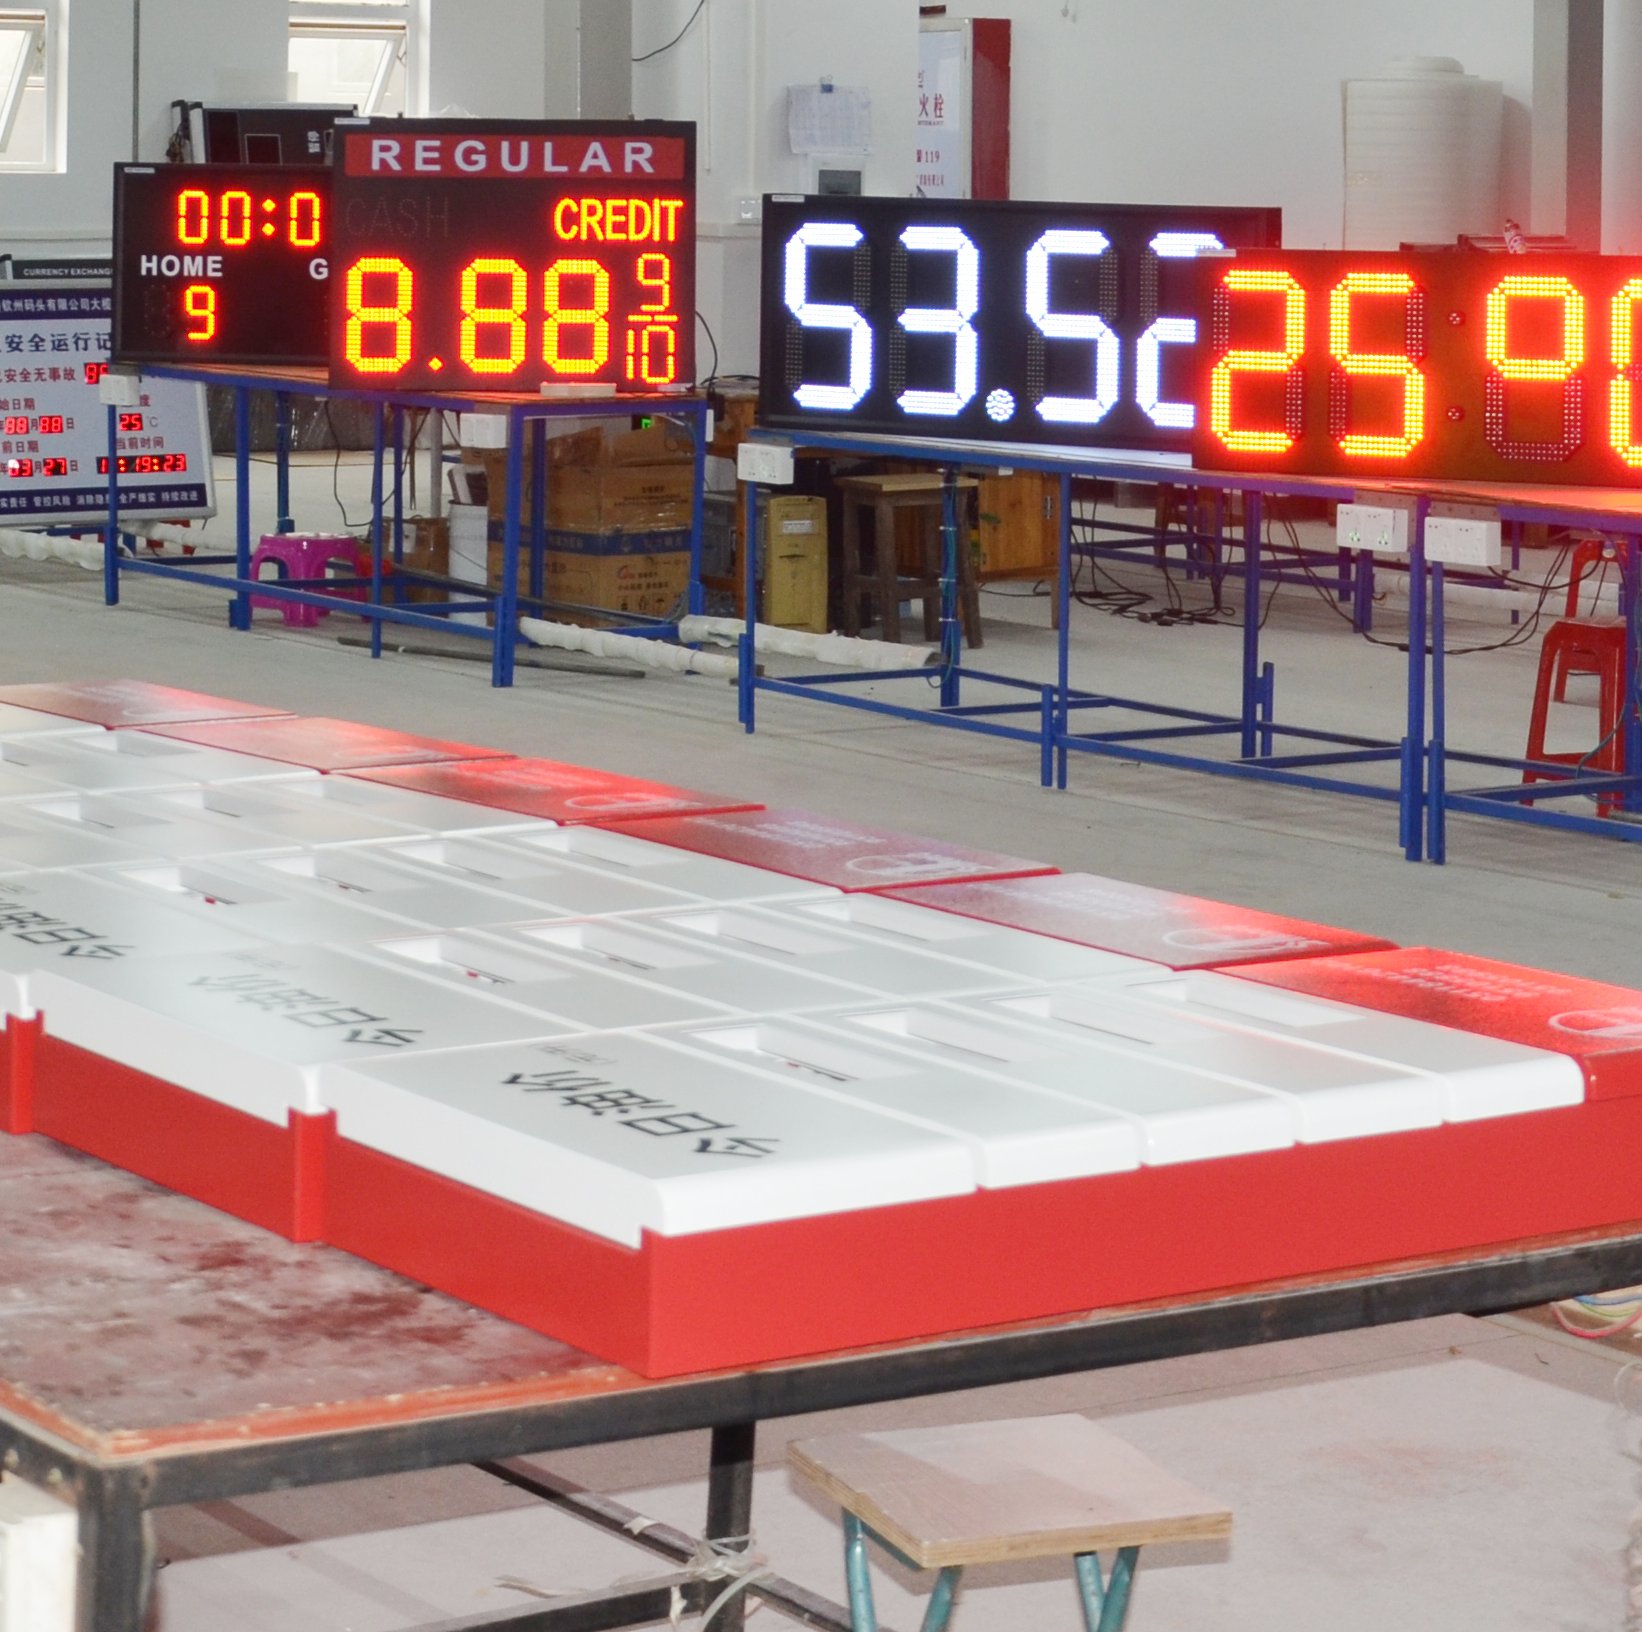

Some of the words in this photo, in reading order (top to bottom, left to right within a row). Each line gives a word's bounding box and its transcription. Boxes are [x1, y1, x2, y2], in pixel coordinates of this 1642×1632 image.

[371, 139, 654, 172] REGULAR
[925, 151, 940, 162] 119
[178, 190, 321, 246] 00:0
[555, 198, 684, 241] CREDIT
[140, 255, 223, 277] HOME
[185, 285, 215, 341] 9
[345, 257, 611, 374] 8.88
[500, 1069, 781, 1158] 今日油价
